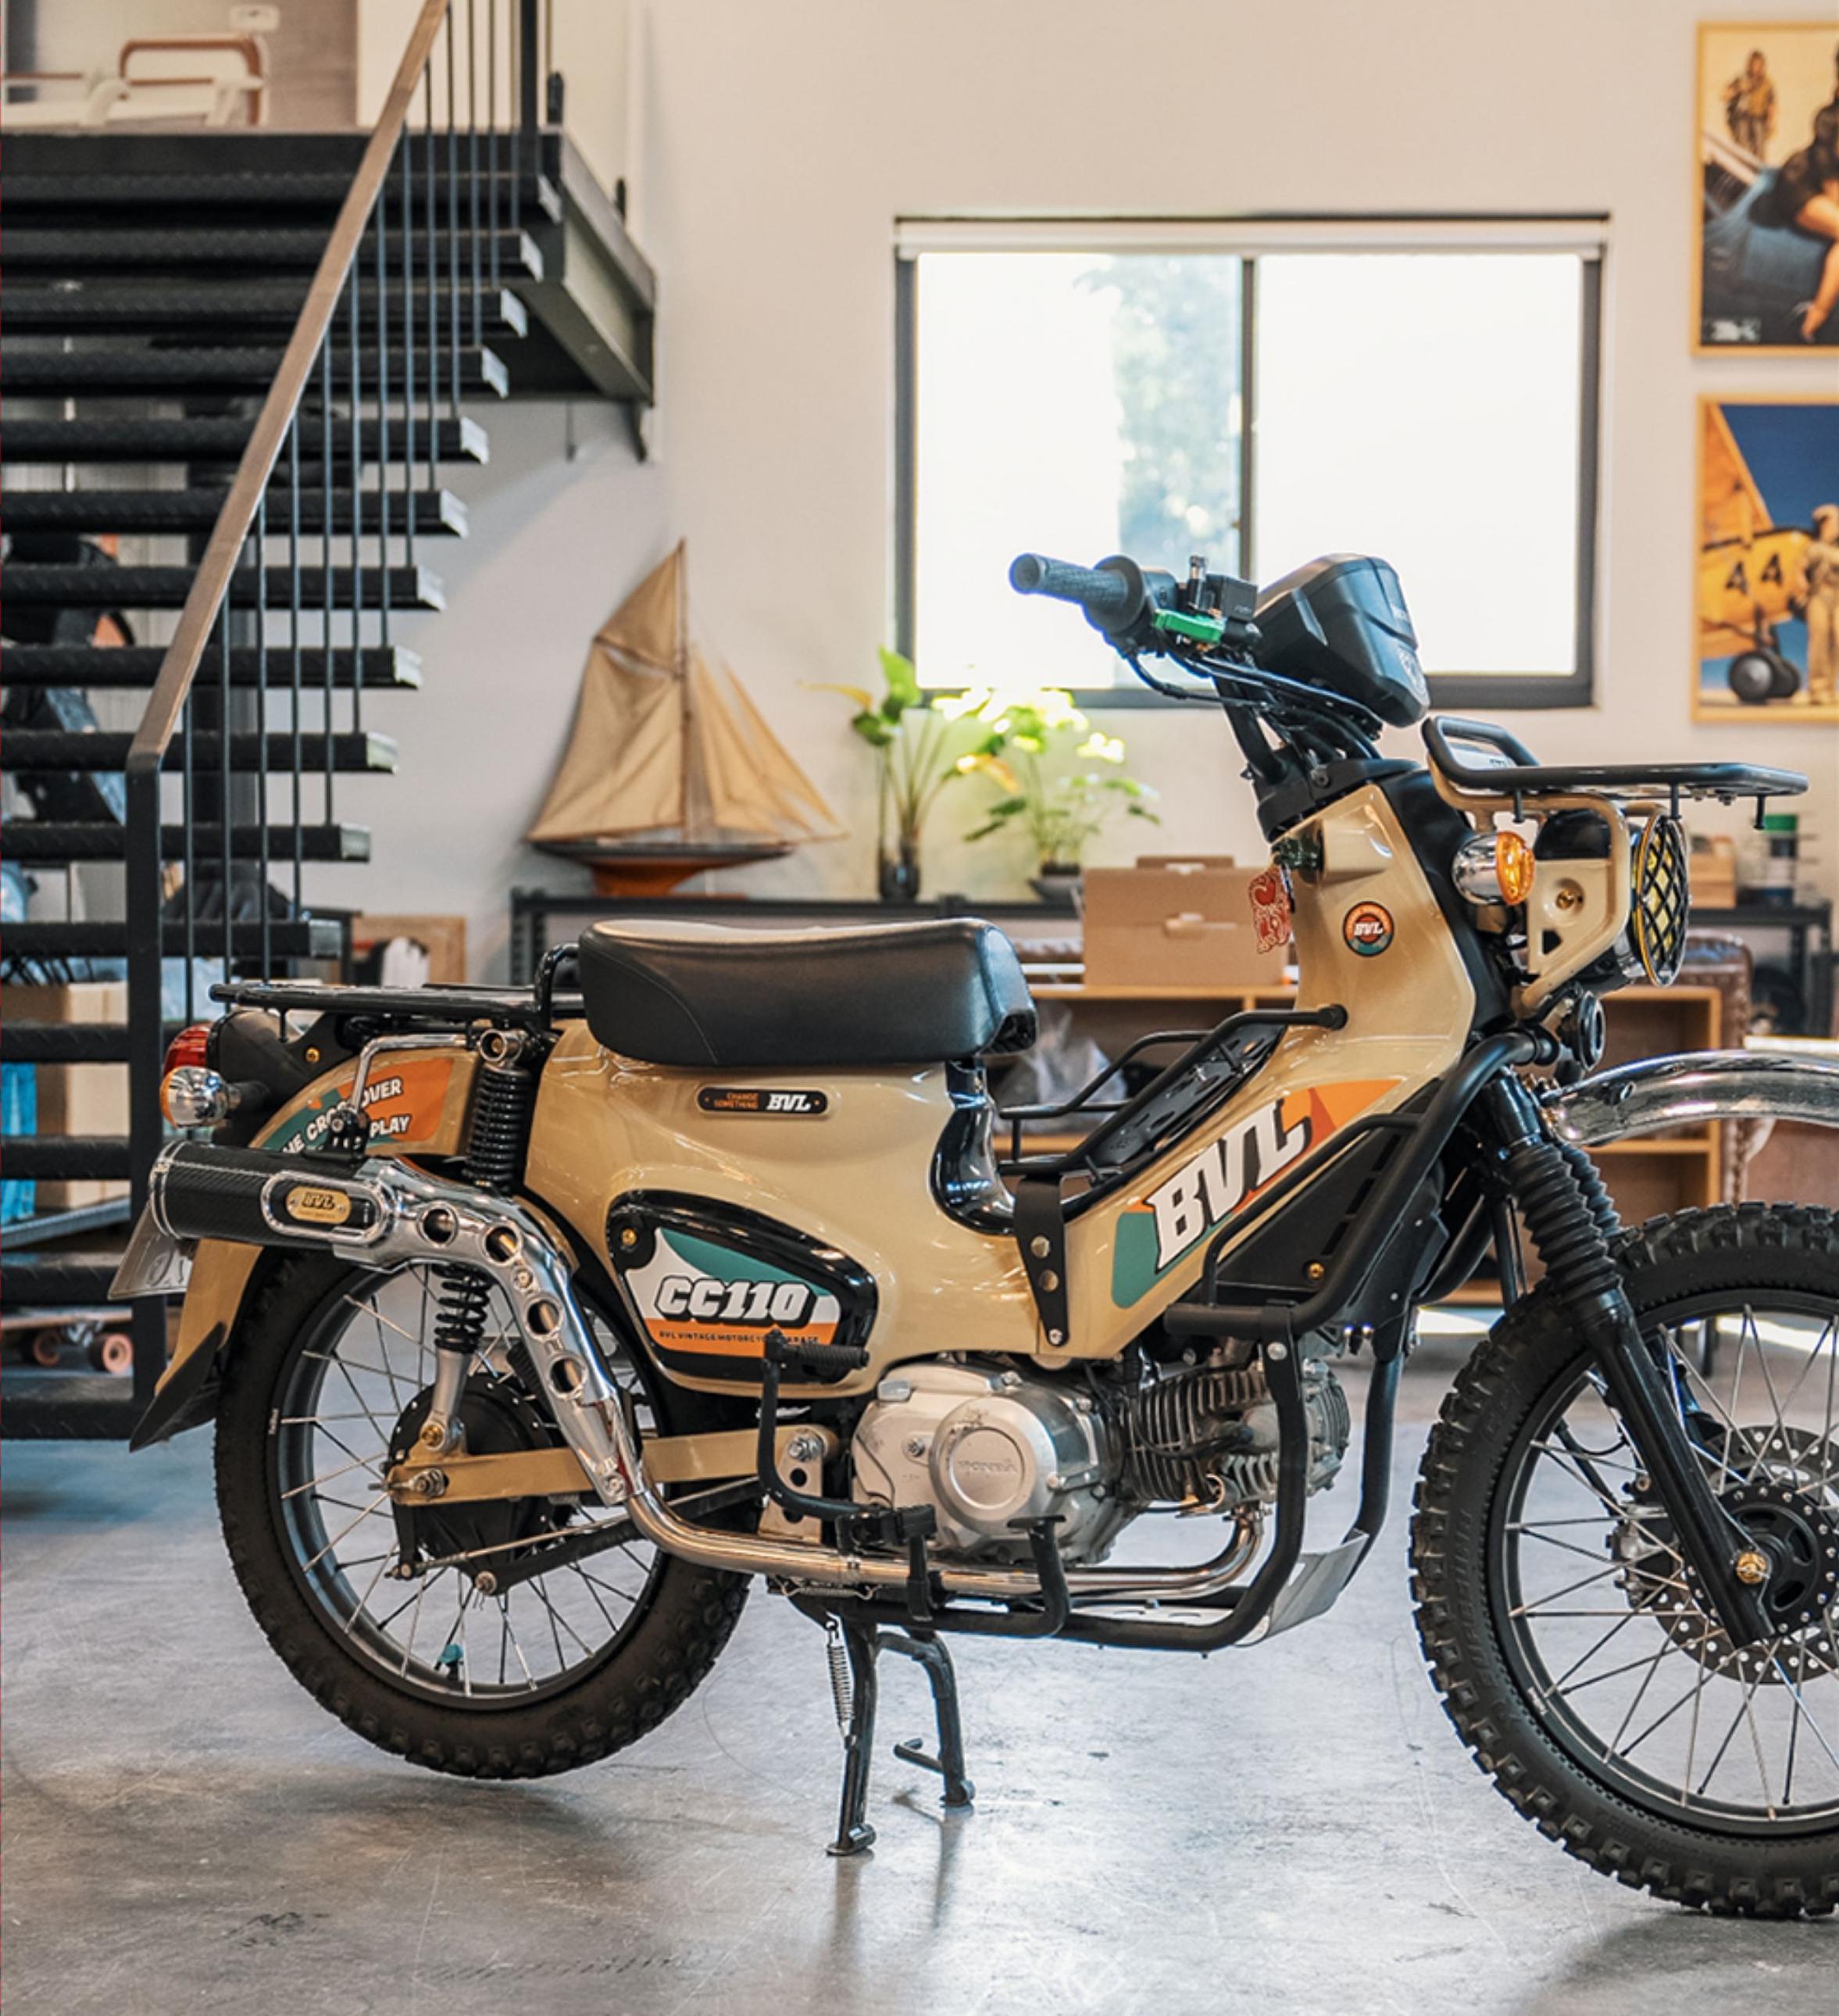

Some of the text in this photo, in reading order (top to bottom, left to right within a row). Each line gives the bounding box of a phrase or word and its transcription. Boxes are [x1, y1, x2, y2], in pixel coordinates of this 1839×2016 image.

[1353, 920, 1384, 936] BVL
[766, 1093, 812, 1111] BVL
[369, 1115, 411, 1138] PLAY
[1144, 1099, 1309, 1272] BVL
[656, 1277, 813, 1324] CC110
[678, 1331, 716, 1342] VINTAGE
